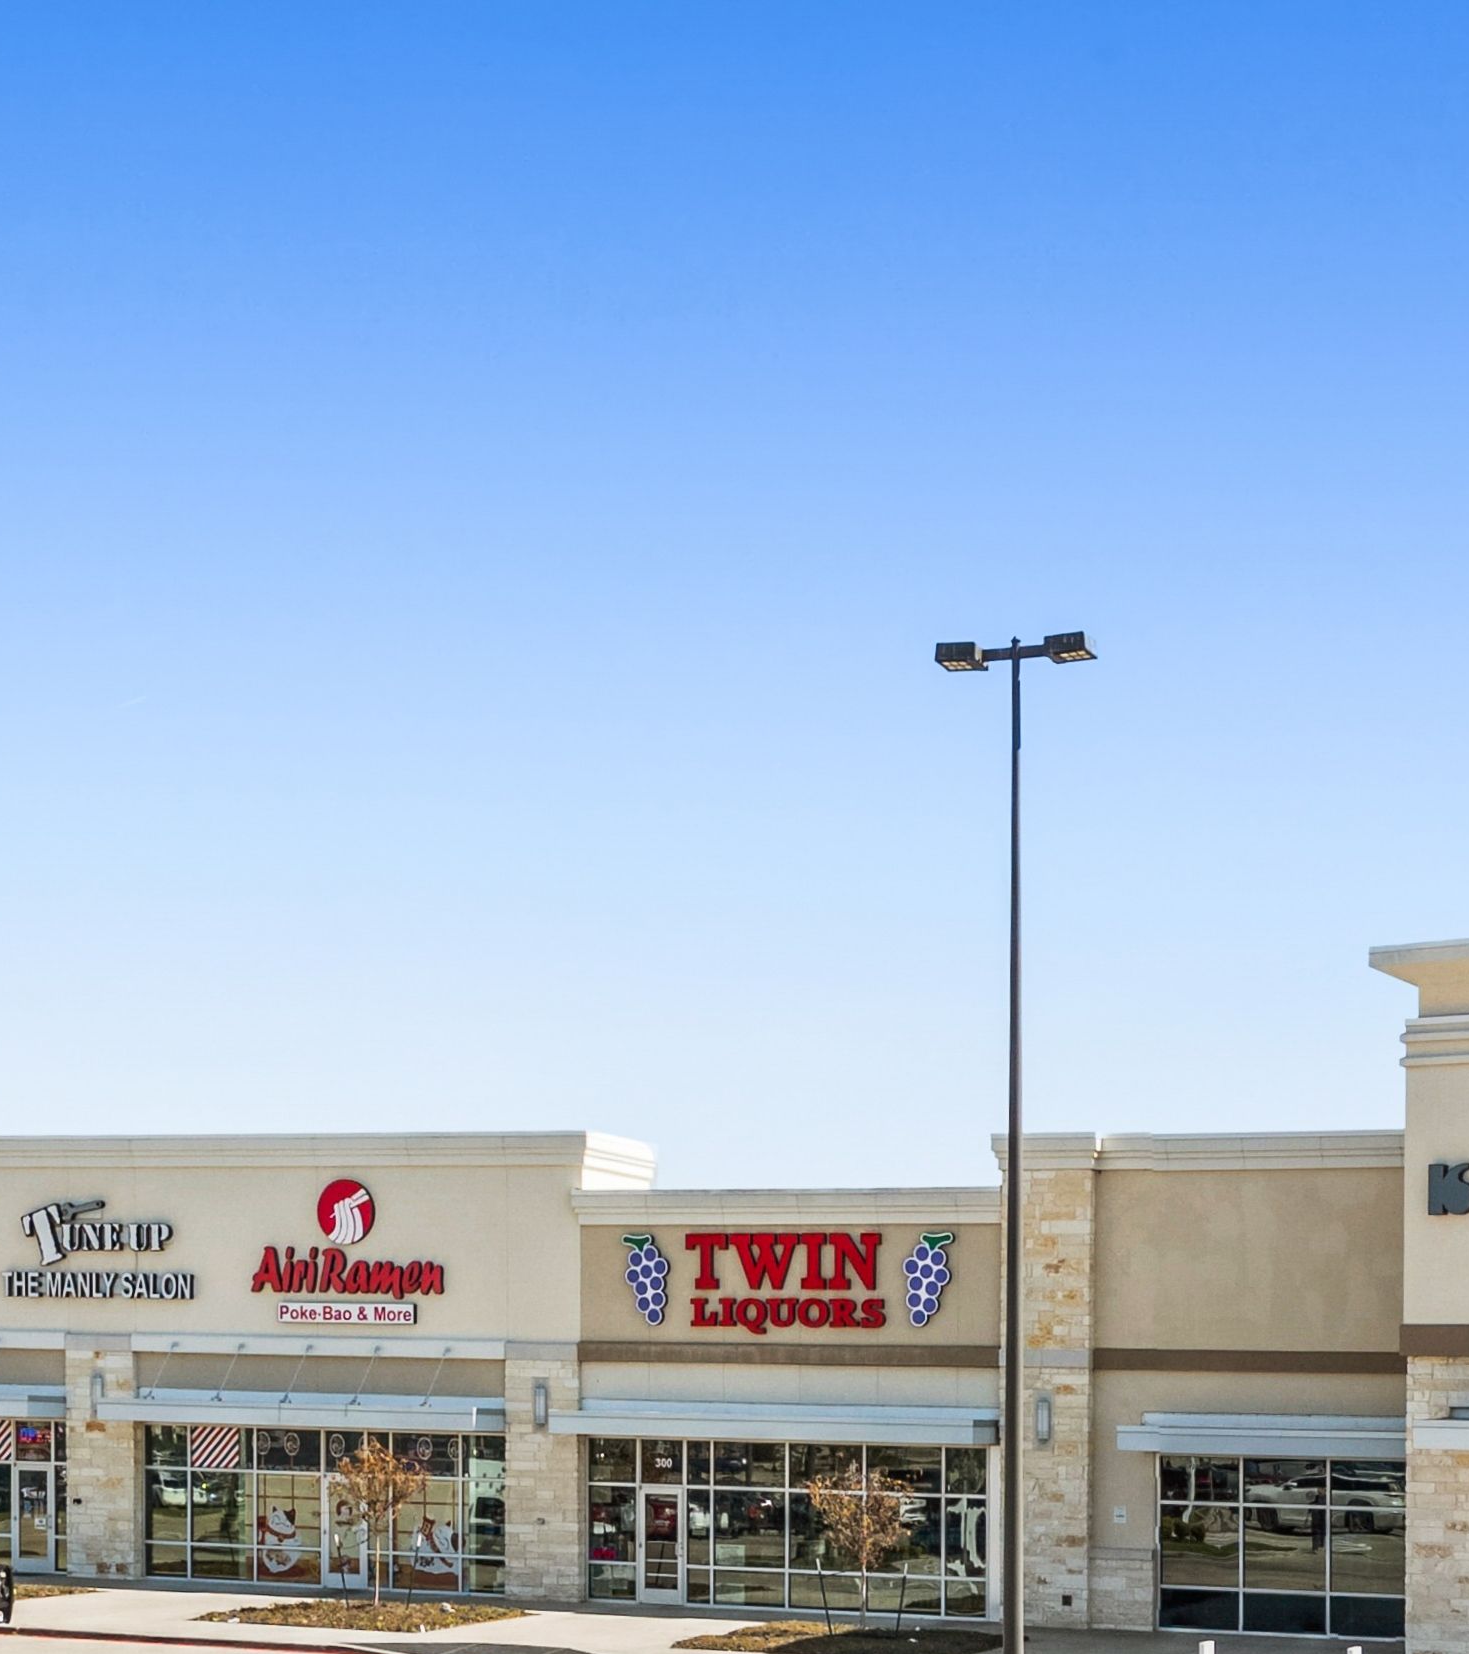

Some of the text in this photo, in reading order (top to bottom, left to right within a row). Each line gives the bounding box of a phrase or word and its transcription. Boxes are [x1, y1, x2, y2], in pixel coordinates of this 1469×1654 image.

[21, 1202, 174, 1267] TUNE UP
[251, 1246, 445, 1301] Airi Ramen
[685, 1232, 882, 1291] TWIN
[2, 1271, 195, 1299] THE MANLY SALON
[357, 1306, 368, 1322] &
[374, 1306, 412, 1323] More
[690, 1298, 886, 1334] LIQUORS
[655, 1457, 673, 1469] 300
